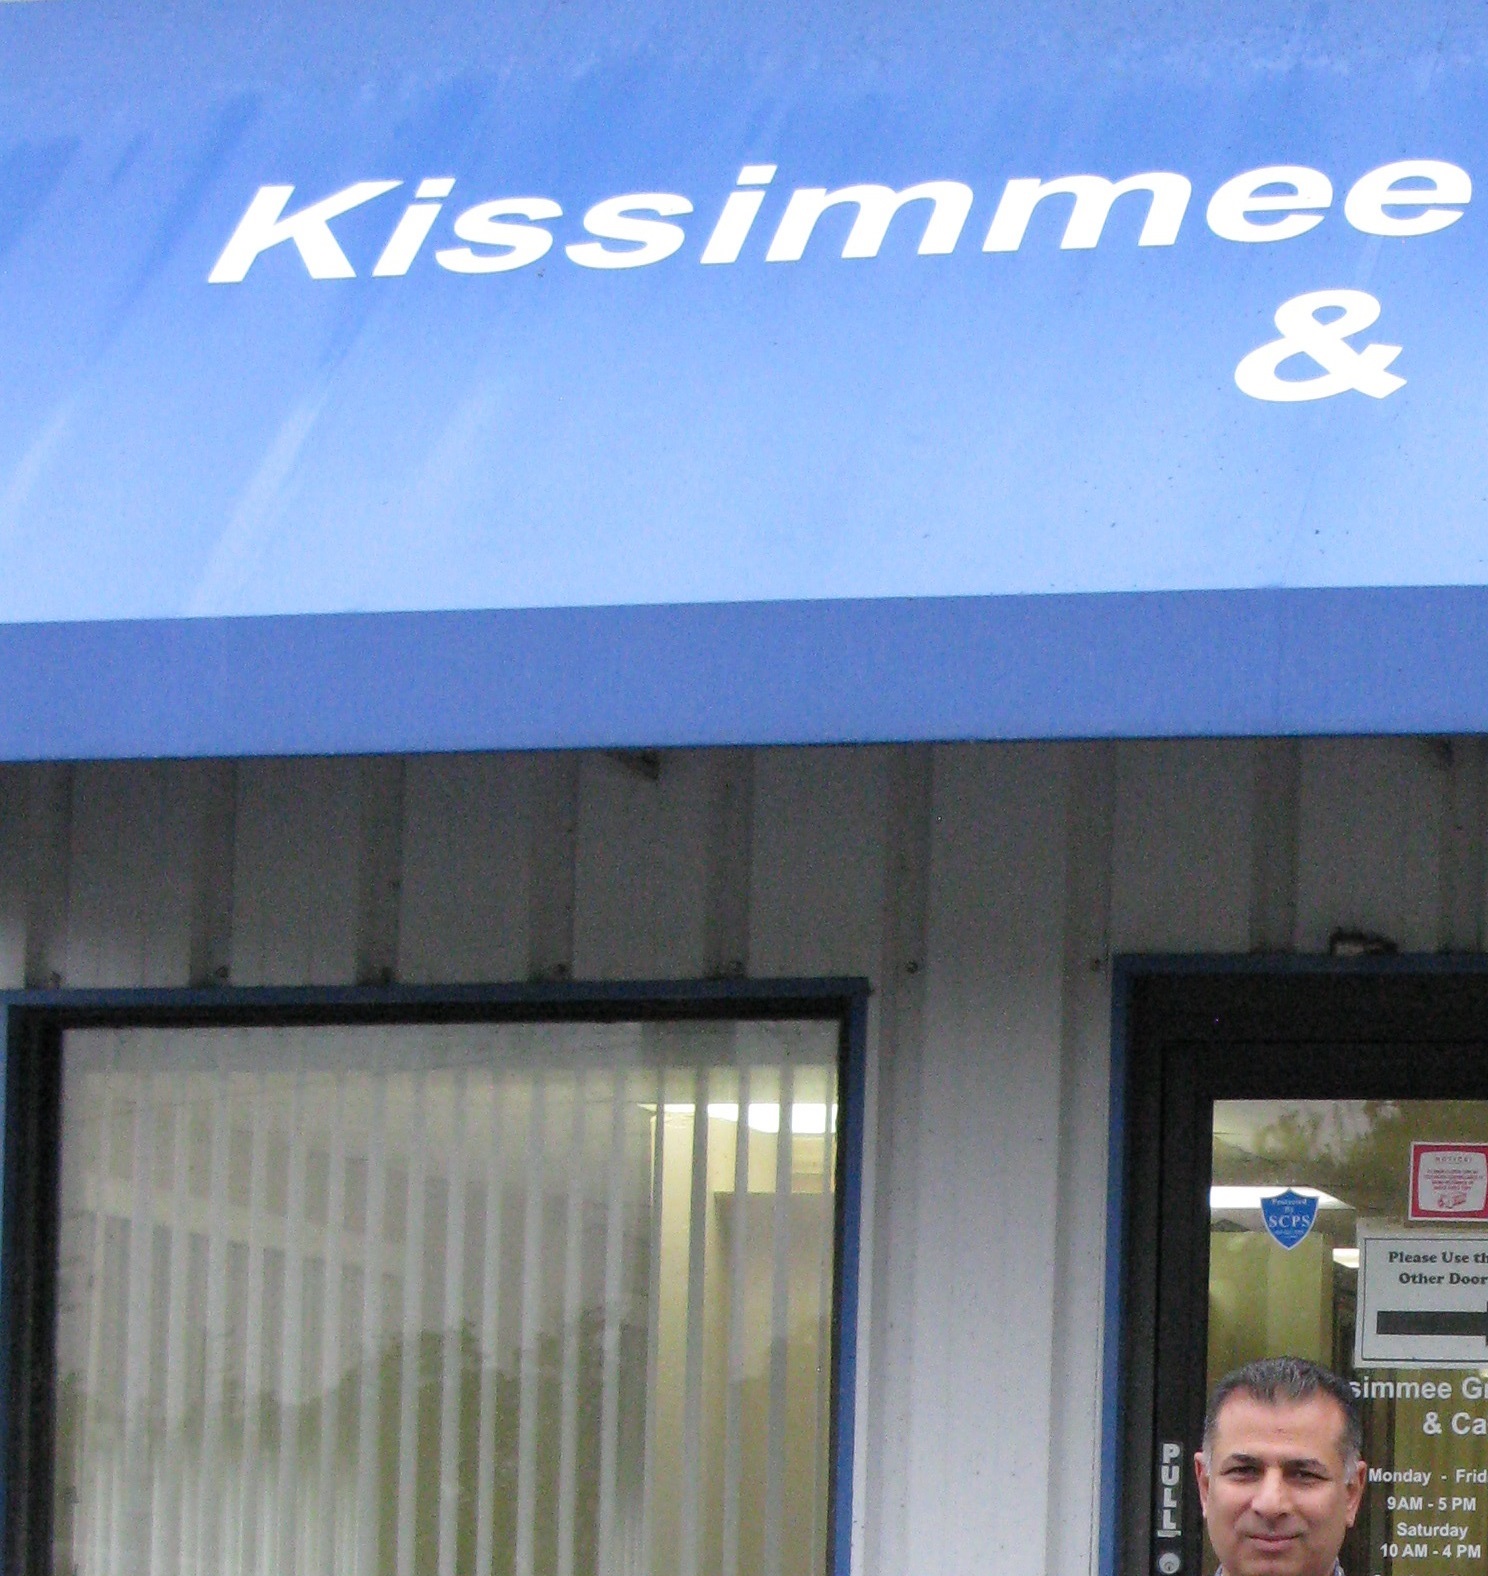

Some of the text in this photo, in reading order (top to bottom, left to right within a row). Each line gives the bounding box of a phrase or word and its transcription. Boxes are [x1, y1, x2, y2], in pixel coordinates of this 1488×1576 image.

[208, 159, 1473, 284] Kissimmee
[1233, 288, 1406, 403] &
[1268, 1214, 1311, 1229] SCPS
[1388, 1250, 1437, 1265] Please
[1441, 1250, 1470, 1265] Use
[1399, 1271, 1488, 1286] Other Door
[1422, 1411, 1443, 1436] &
[1368, 1467, 1432, 1486] Monday
[1160, 1443, 1181, 1530] PULL
[1437, 1497, 1448, 1512] 5
[1451, 1497, 1476, 1512] PM
[1396, 1522, 1469, 1540] Saturday
[1379, 1543, 1399, 1558] 10
[1401, 1544, 1428, 1558] AM
[1441, 1544, 1452, 1558] 4
[1456, 1544, 1481, 1558] PM
